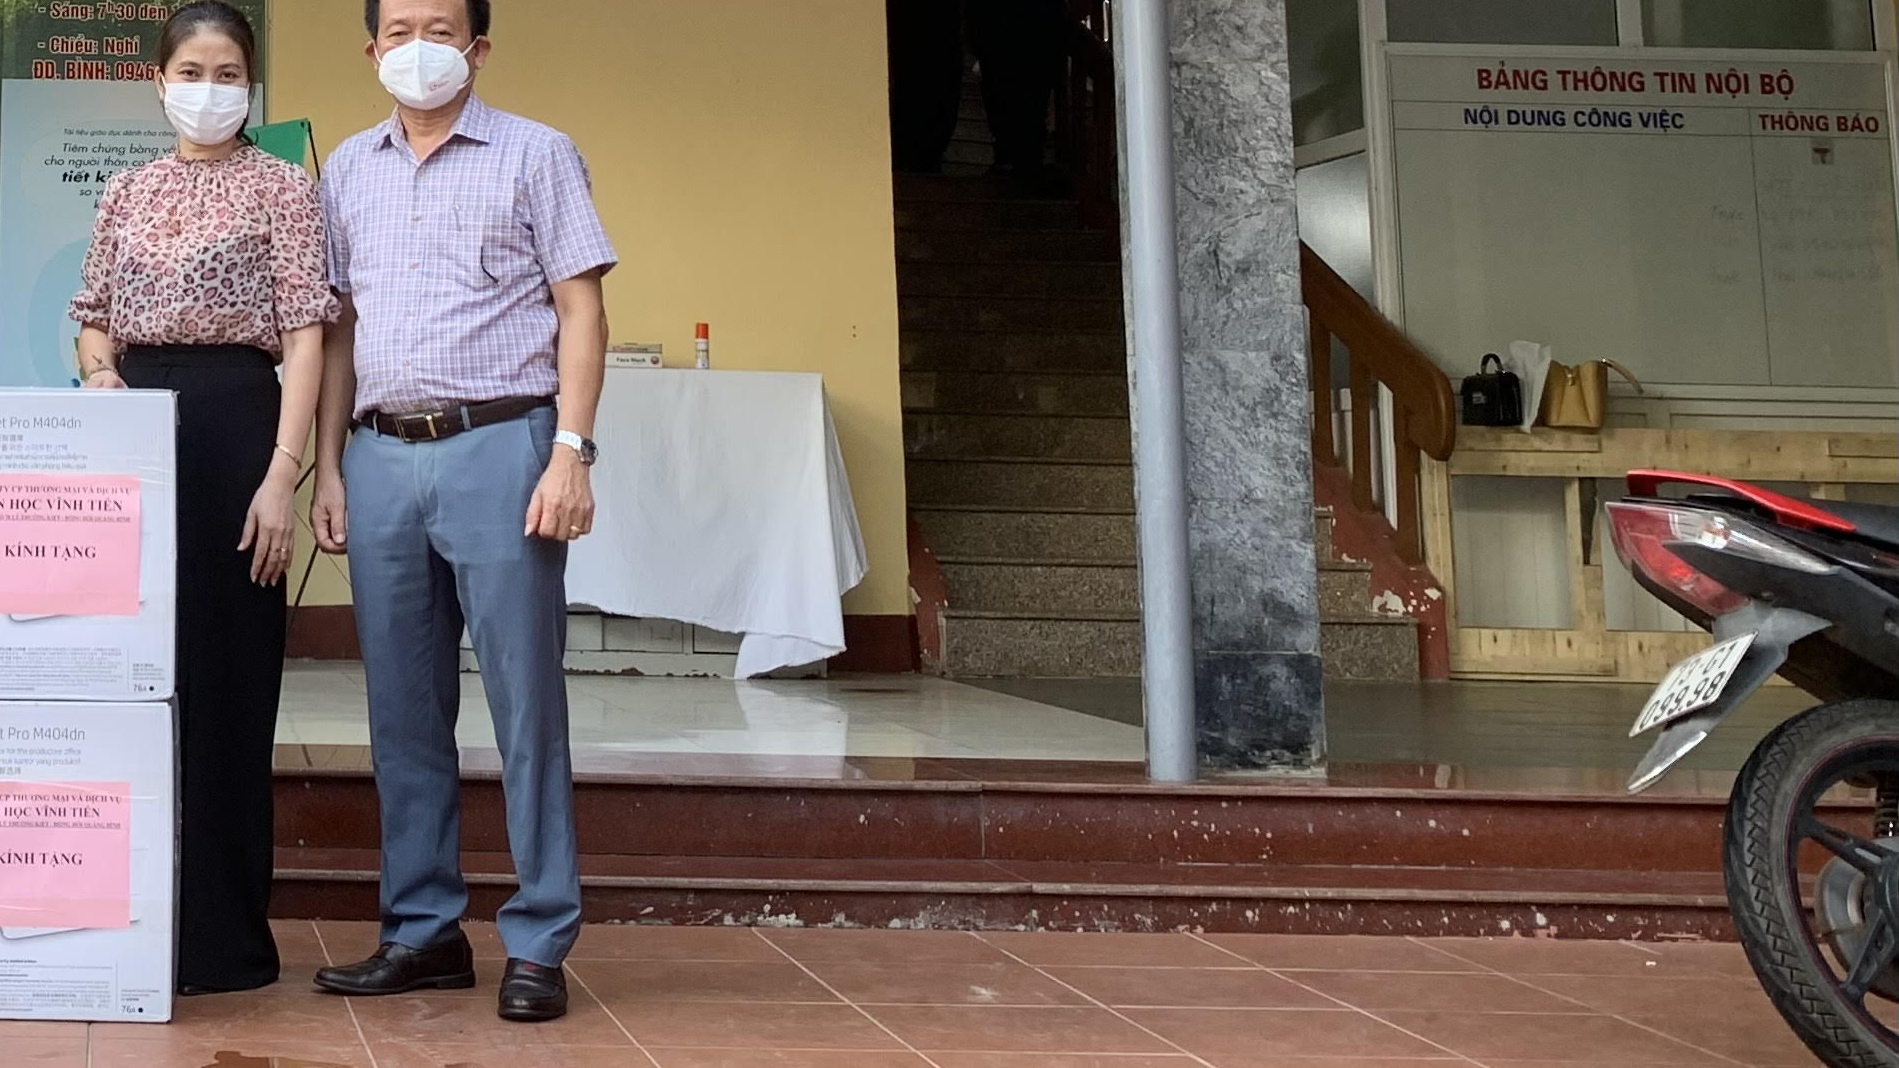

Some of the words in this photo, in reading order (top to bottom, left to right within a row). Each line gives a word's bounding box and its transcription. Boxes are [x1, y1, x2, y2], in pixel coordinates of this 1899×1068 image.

[50, 33, 99, 55] Chiều:
[33, 60, 61, 81] ĐD.
[66, 55, 111, 81] BÌNH:
[115, 61, 156, 81] 0946
[1476, 61, 1549, 92] BẢNG
[1556, 65, 1645, 94] THÔNG
[1653, 71, 1697, 94] TIN
[1705, 68, 1750, 100] NỘI
[1759, 68, 1795, 101] BỘ
[1463, 106, 1500, 129] NỘI
[1507, 109, 1566, 128] DUNG
[1573, 106, 1632, 129] CÔNG
[1638, 108, 1685, 132] VIỆC
[1758, 111, 1830, 133] THÔNG
[1835, 110, 1879, 134] BÁO
[44, 154, 64, 166] cho
[62, 170, 90, 183] tiết
[9, 416, 30, 430] Pro
[33, 416, 82, 430] M404dn
[10, 498, 42, 513] HỌC
[46, 496, 83, 511] VĨNH
[5, 541, 45, 558] KÍNH
[1638, 670, 1727, 731] 099.98
[8, 726, 30, 740] Pro
[33, 727, 85, 740] M404dn
[4, 807, 31, 819] HỌC
[35, 804, 66, 818] VĨNH
